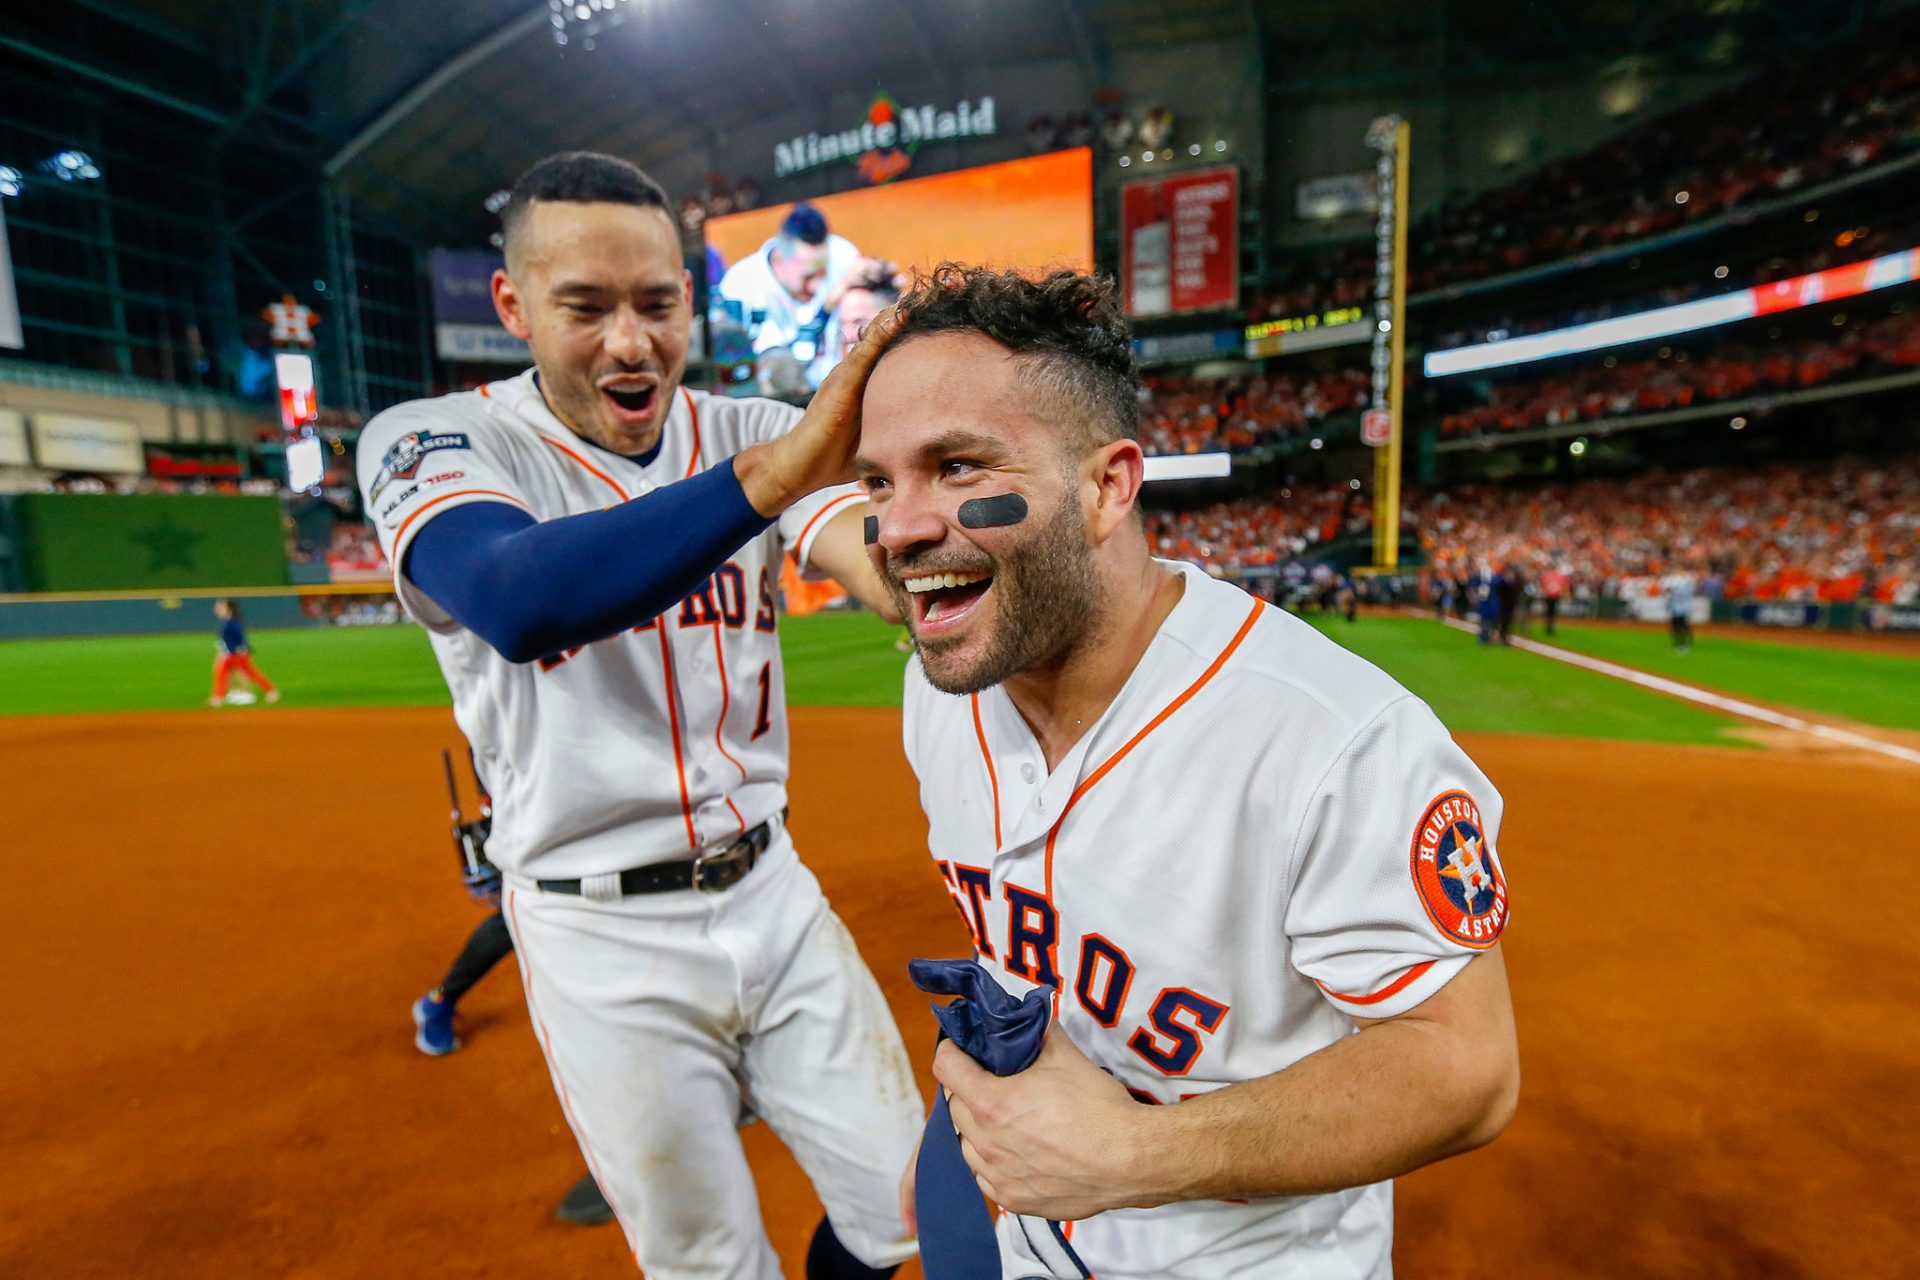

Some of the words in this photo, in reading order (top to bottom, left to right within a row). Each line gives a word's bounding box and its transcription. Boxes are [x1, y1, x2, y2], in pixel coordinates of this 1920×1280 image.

[774, 120, 897, 178] Minute
[900, 96, 996, 143] Maid
[750, 660, 770, 742] 1
[1420, 799, 1480, 862] HOUSTON
[1458, 883, 1507, 938] ASTROS
